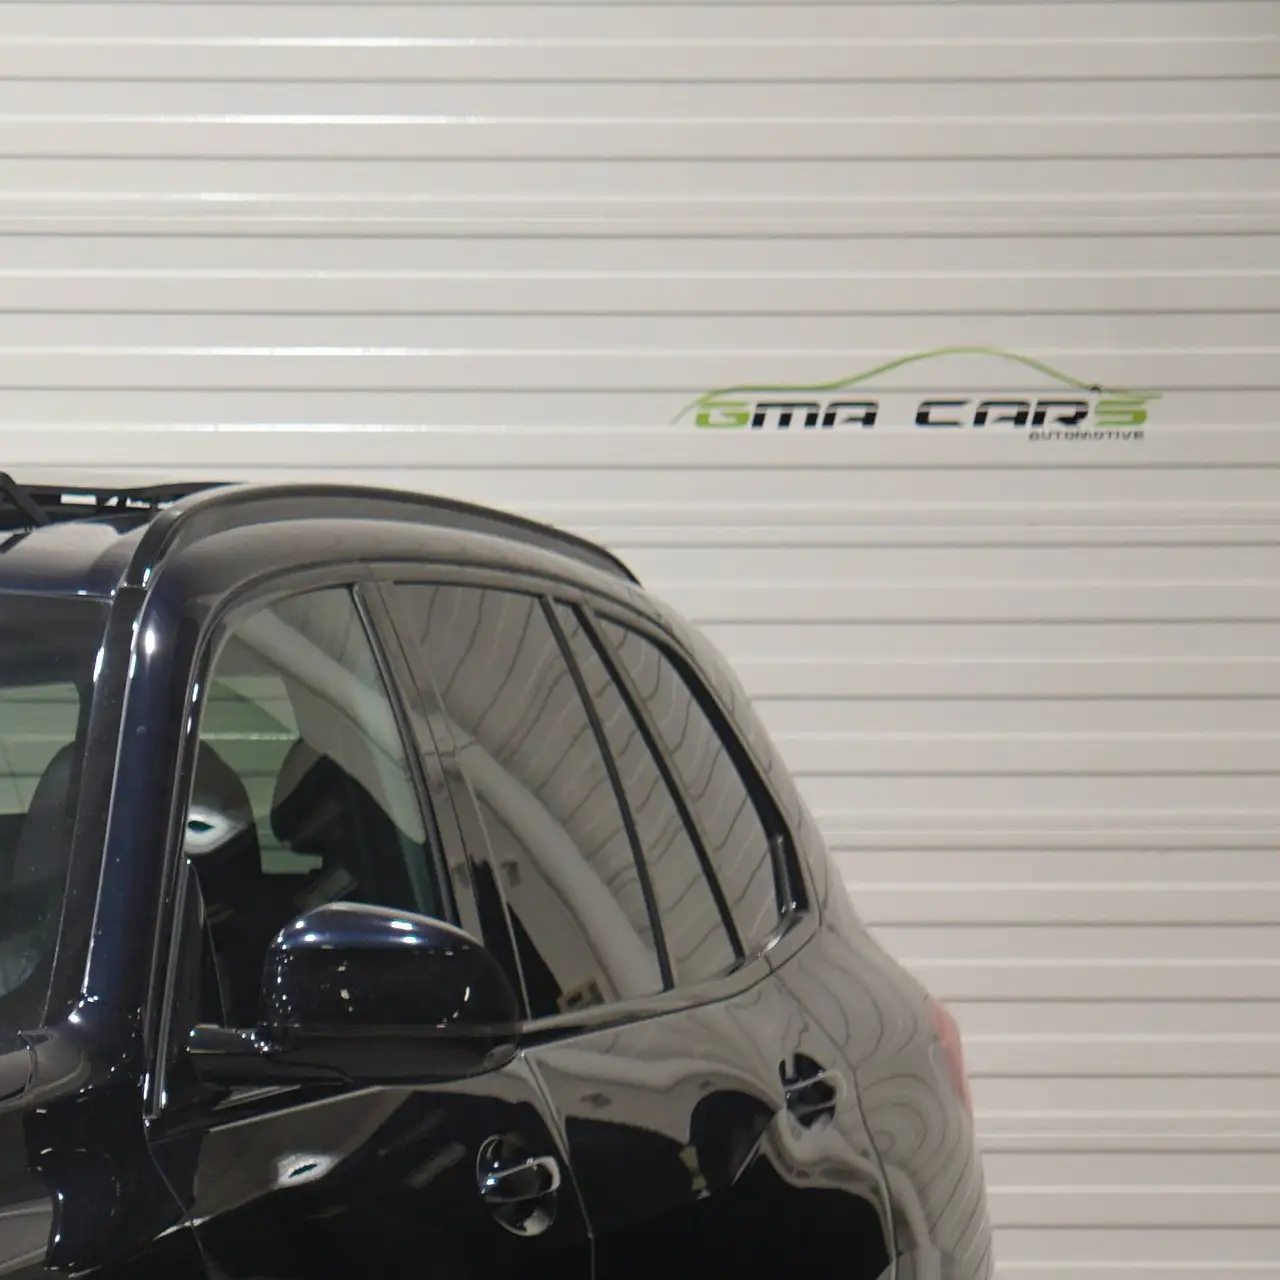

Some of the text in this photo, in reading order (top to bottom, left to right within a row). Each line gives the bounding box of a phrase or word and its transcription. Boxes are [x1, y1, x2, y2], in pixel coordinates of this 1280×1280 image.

[696, 400, 1148, 428] GMA CARS
[1028, 430, 1145, 441] AUTOMOTIVE
